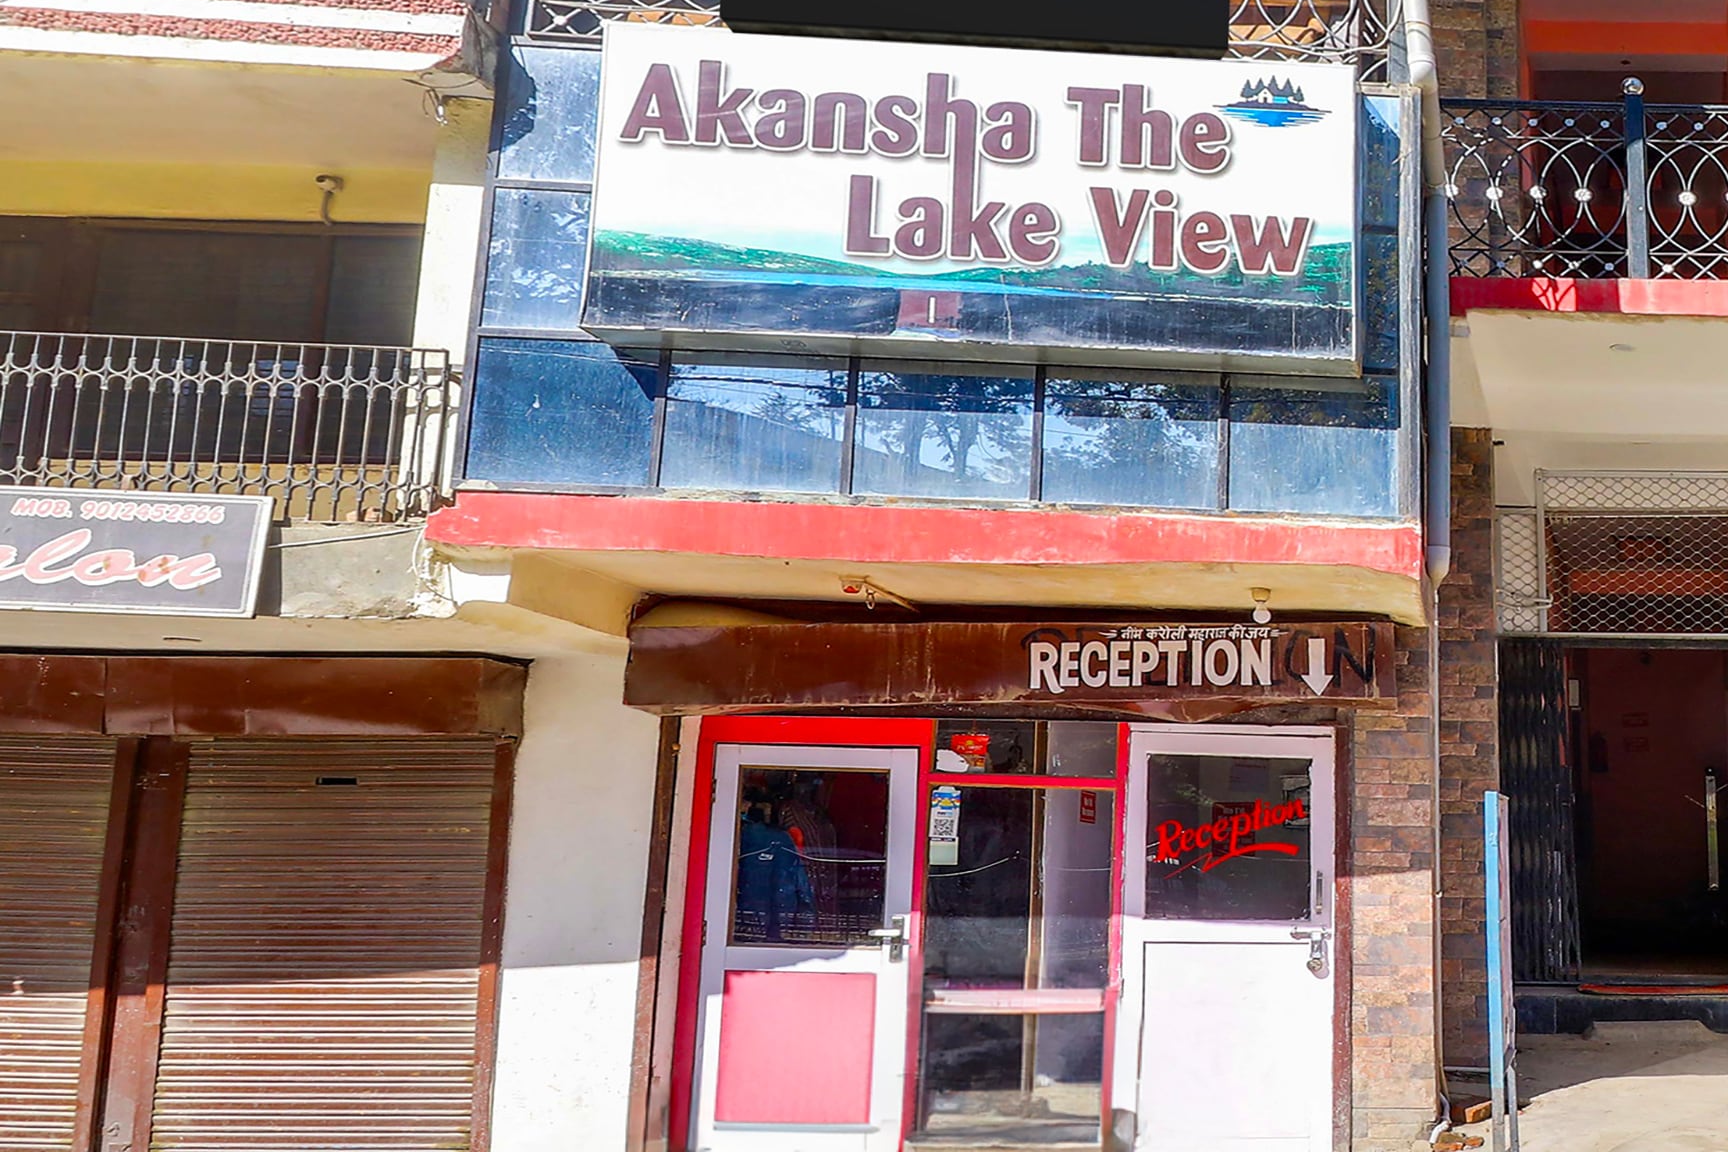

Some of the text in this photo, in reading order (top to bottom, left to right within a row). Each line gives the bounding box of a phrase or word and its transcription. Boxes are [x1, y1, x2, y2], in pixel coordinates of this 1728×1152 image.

[618, 59, 1234, 176] Akansha The
[842, 166, 1316, 278] Lake View
[10, 497, 225, 524] MOB. 9012452866
[1029, 638, 1273, 694] RECEPTION
[1153, 796, 1307, 864] Reception
